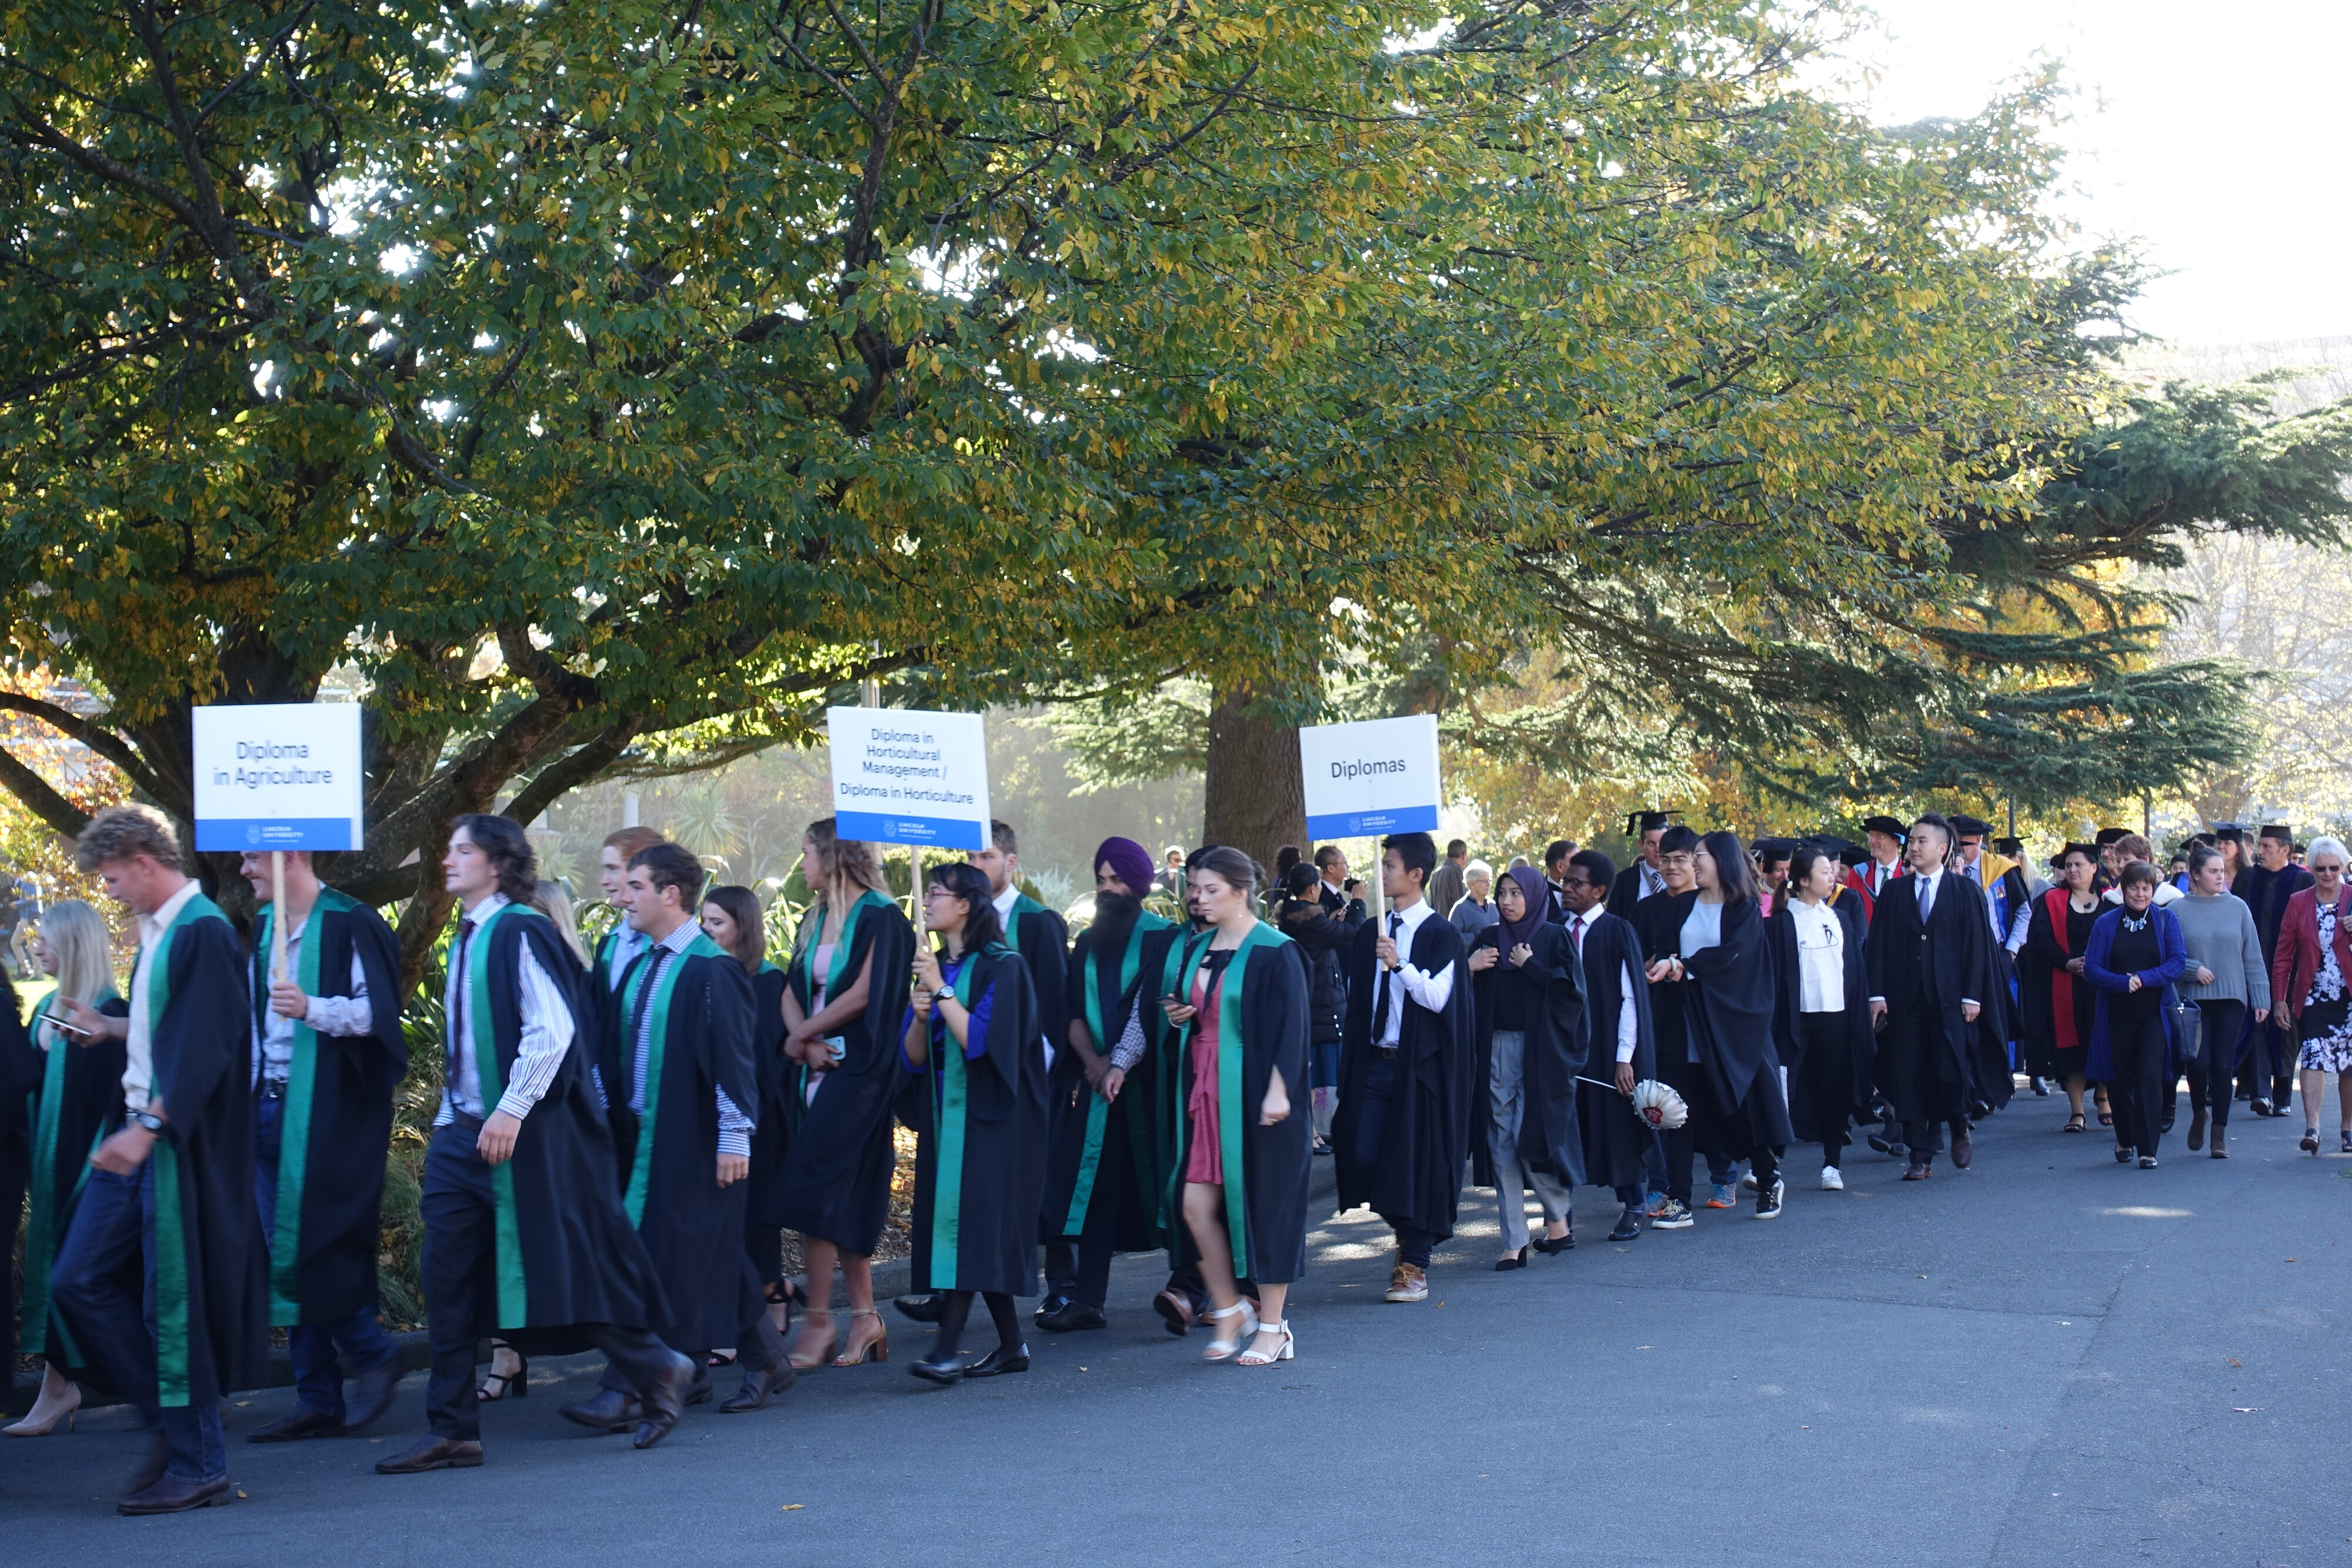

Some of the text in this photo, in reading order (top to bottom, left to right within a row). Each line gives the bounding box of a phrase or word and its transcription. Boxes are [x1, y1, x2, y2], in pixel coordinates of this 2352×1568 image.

[871, 728, 934, 744] Diploma in
[236, 740, 309, 763] Diploma
[866, 745, 941, 761] Horticultural
[213, 765, 333, 789] in Agriculture
[862, 761, 948, 780] Management /
[1331, 758, 1406, 780] Diplomas
[840, 783, 974, 804] Diploma in Horticulture
